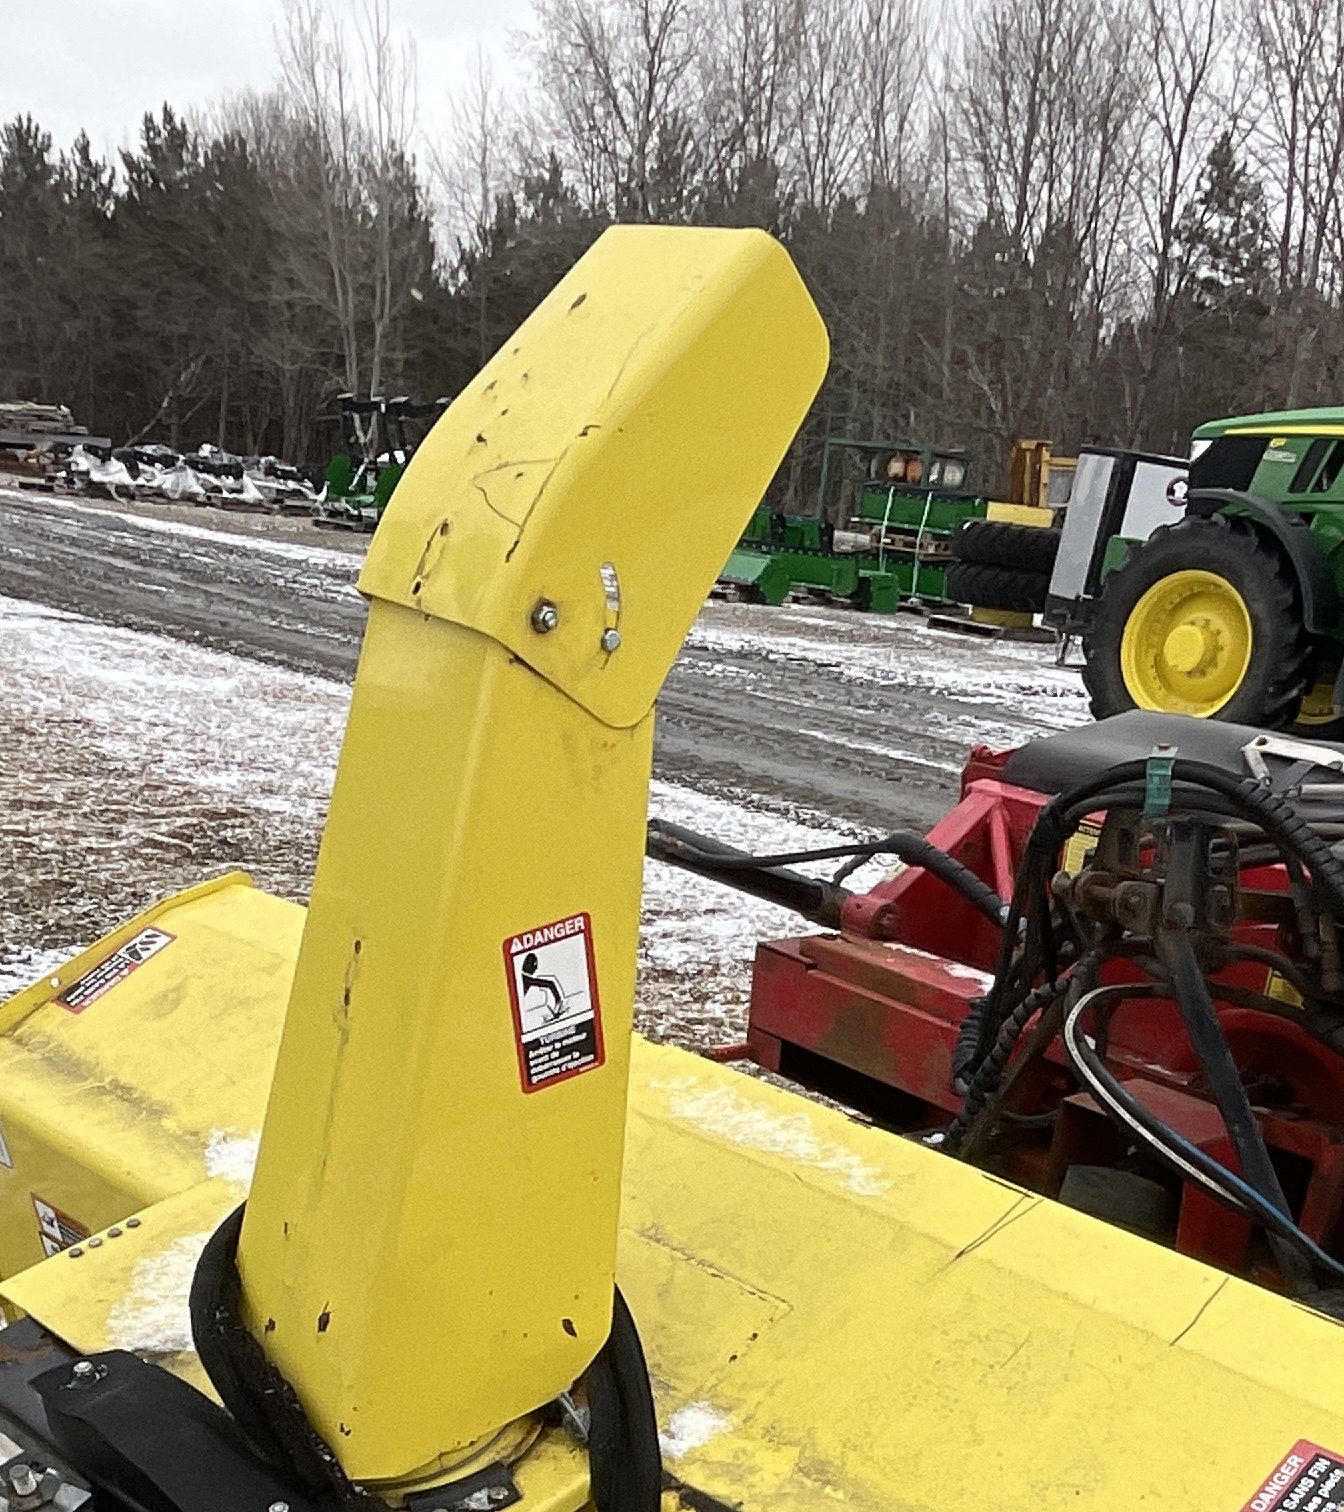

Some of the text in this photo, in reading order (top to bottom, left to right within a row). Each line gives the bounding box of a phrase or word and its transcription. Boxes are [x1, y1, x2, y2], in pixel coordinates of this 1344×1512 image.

[523, 916, 586, 949] DANGER
[1251, 1455, 1304, 1512] DANGER
[1282, 1476, 1316, 1510] SANS
[1308, 1457, 1331, 1478] FIN
